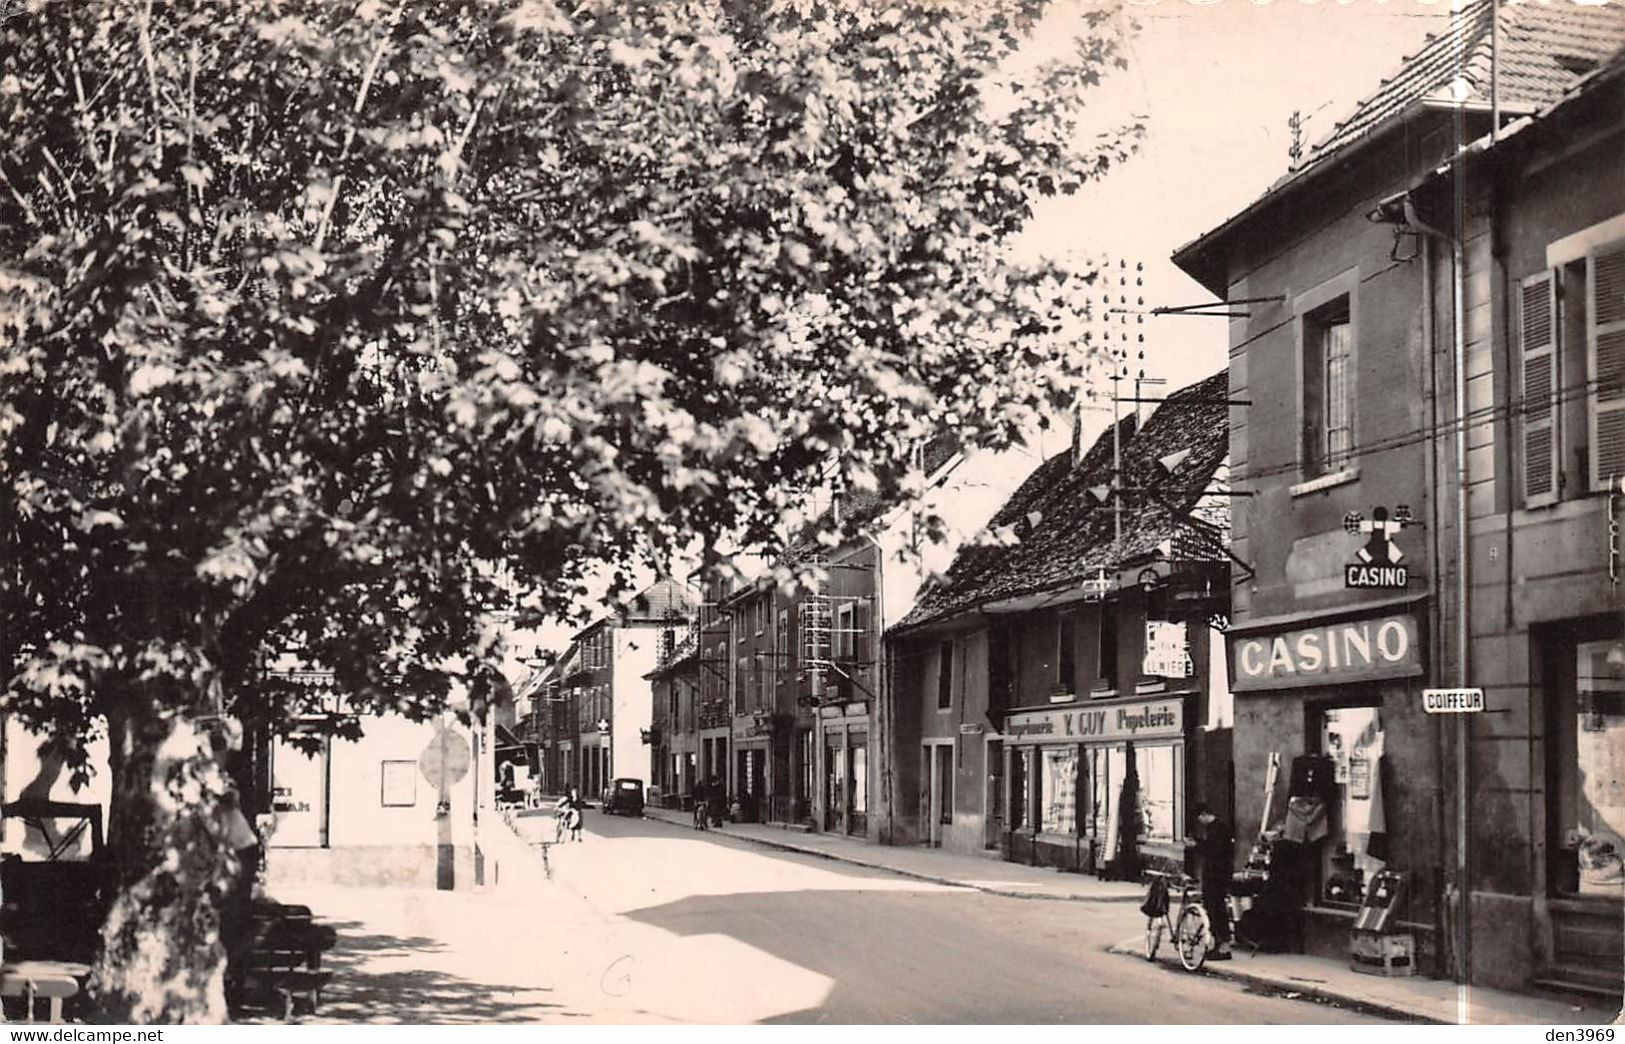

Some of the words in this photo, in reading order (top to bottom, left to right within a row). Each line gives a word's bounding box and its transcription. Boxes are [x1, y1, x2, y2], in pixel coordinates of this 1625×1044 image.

[1348, 566, 1406, 586] CASINO
[1240, 620, 1408, 676] CASINO
[1427, 692, 1482, 708] COIFFEUR
[1079, 711, 1106, 735] GUY
